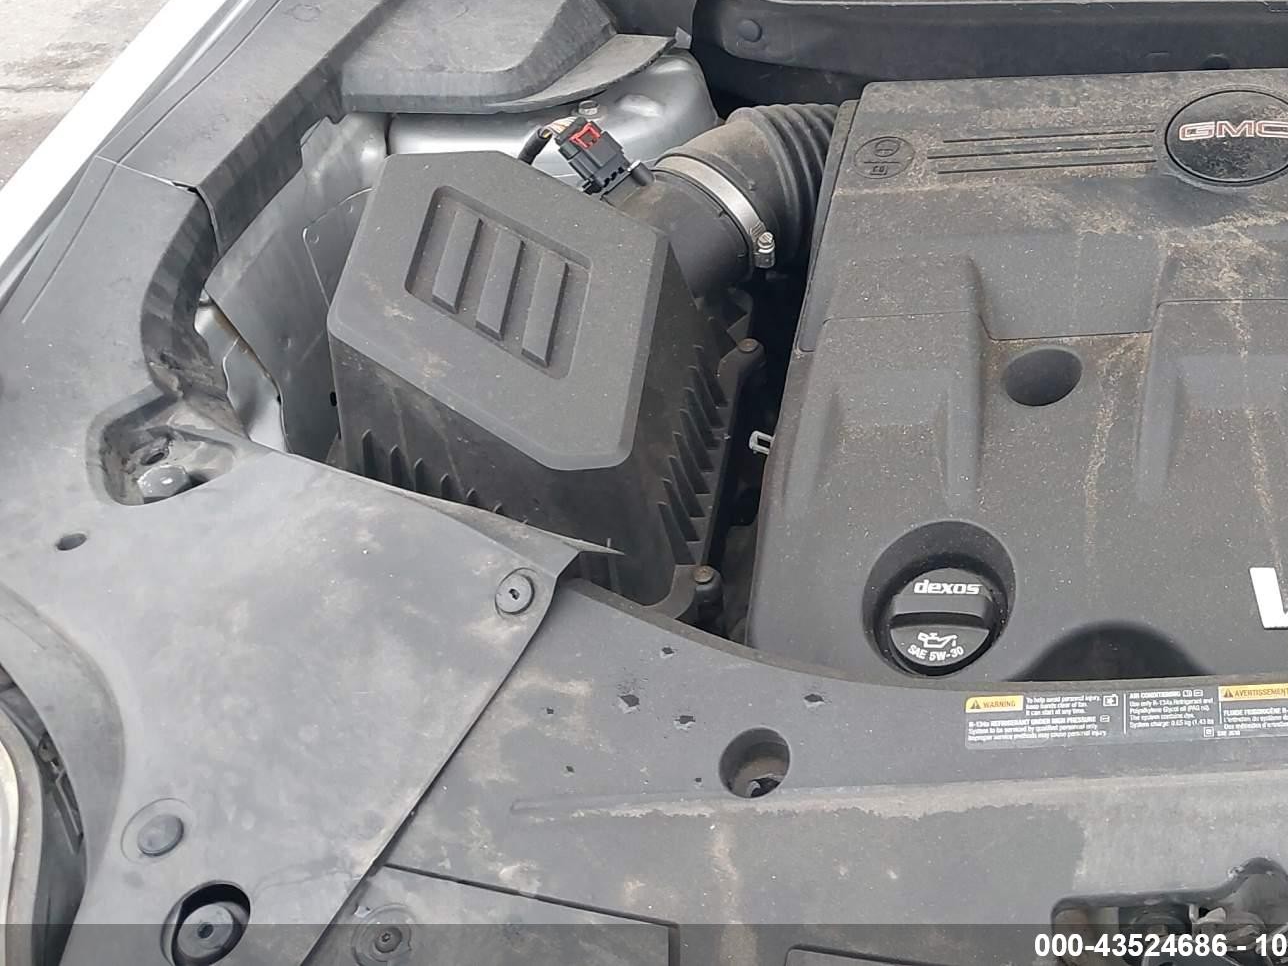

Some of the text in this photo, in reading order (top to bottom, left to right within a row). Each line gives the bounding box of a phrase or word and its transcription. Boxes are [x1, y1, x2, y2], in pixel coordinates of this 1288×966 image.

[914, 579, 982, 595] dexos
[908, 644, 964, 661] SAE 5W-30
[1235, 688, 1288, 697] AVERTISSEMENT
[984, 700, 1015, 708] WARNING
